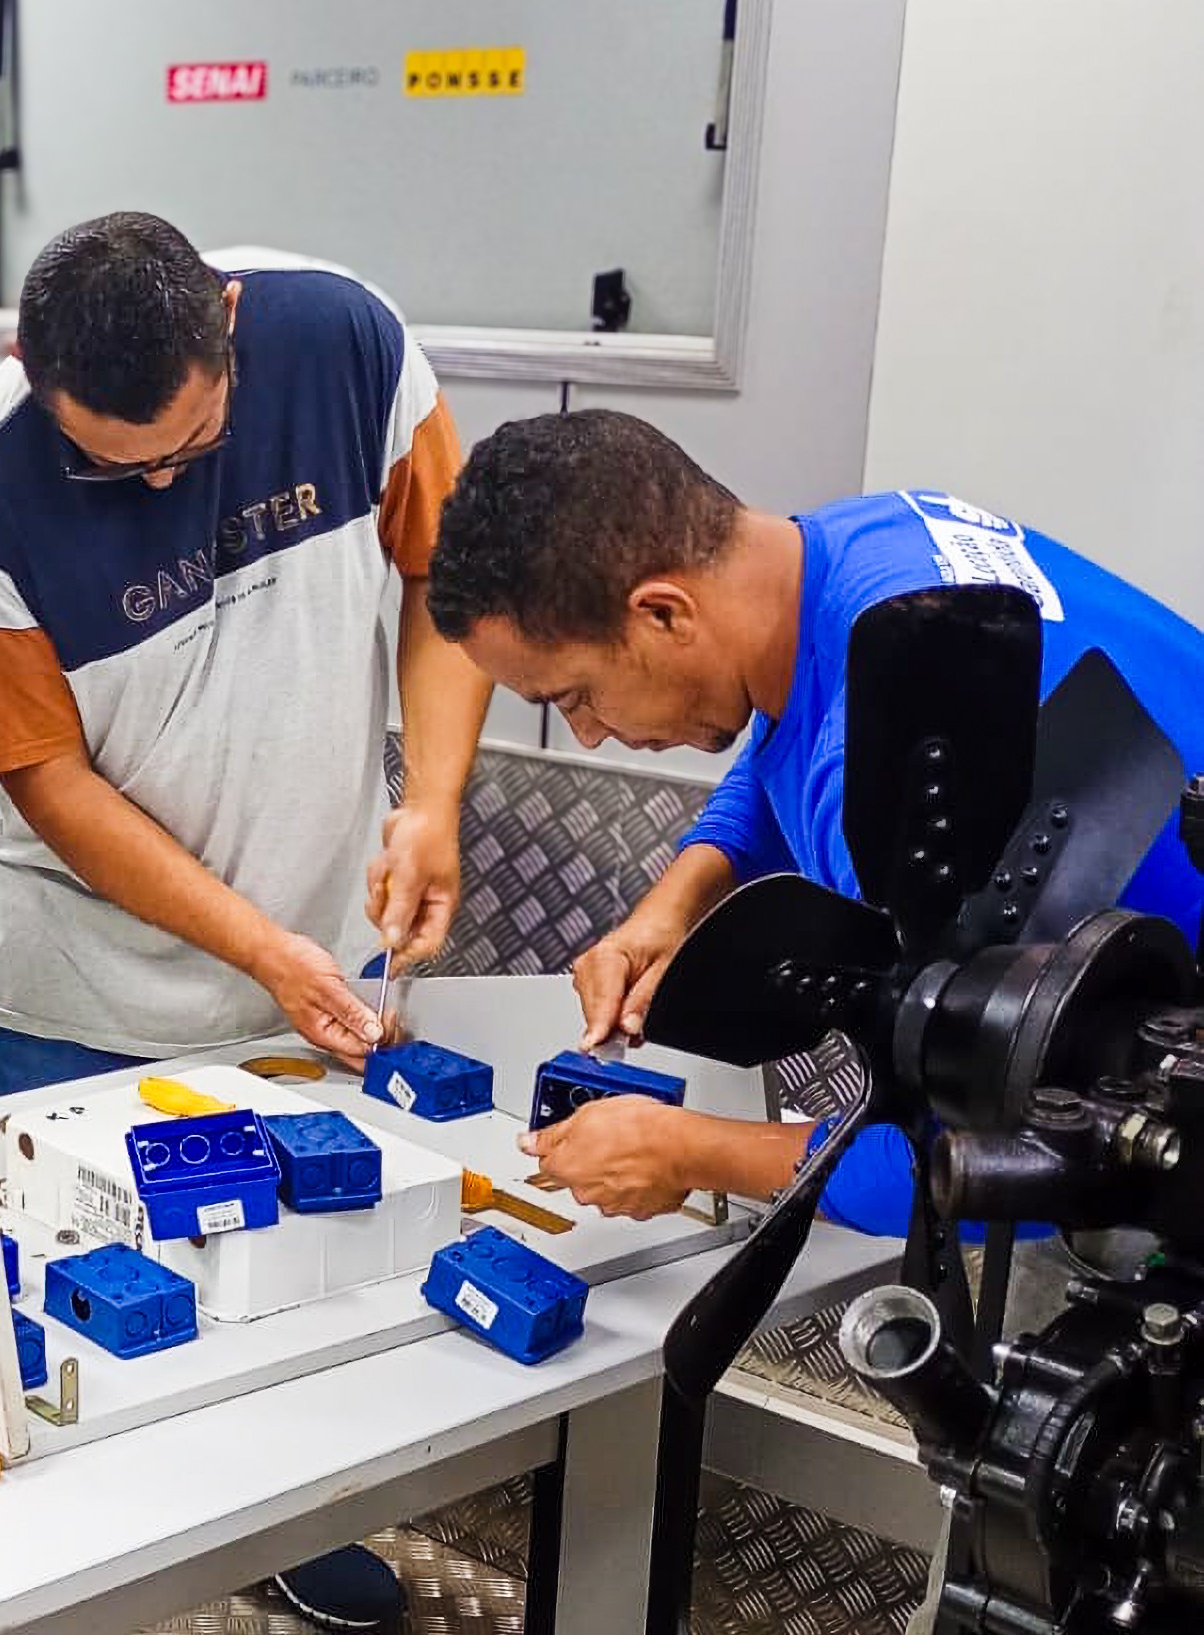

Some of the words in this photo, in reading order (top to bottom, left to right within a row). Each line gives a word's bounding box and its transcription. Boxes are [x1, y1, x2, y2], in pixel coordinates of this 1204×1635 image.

[171, 64, 264, 98] SENAI
[407, 69, 522, 92] PONSSE
[123, 483, 323, 622] GANSTER
